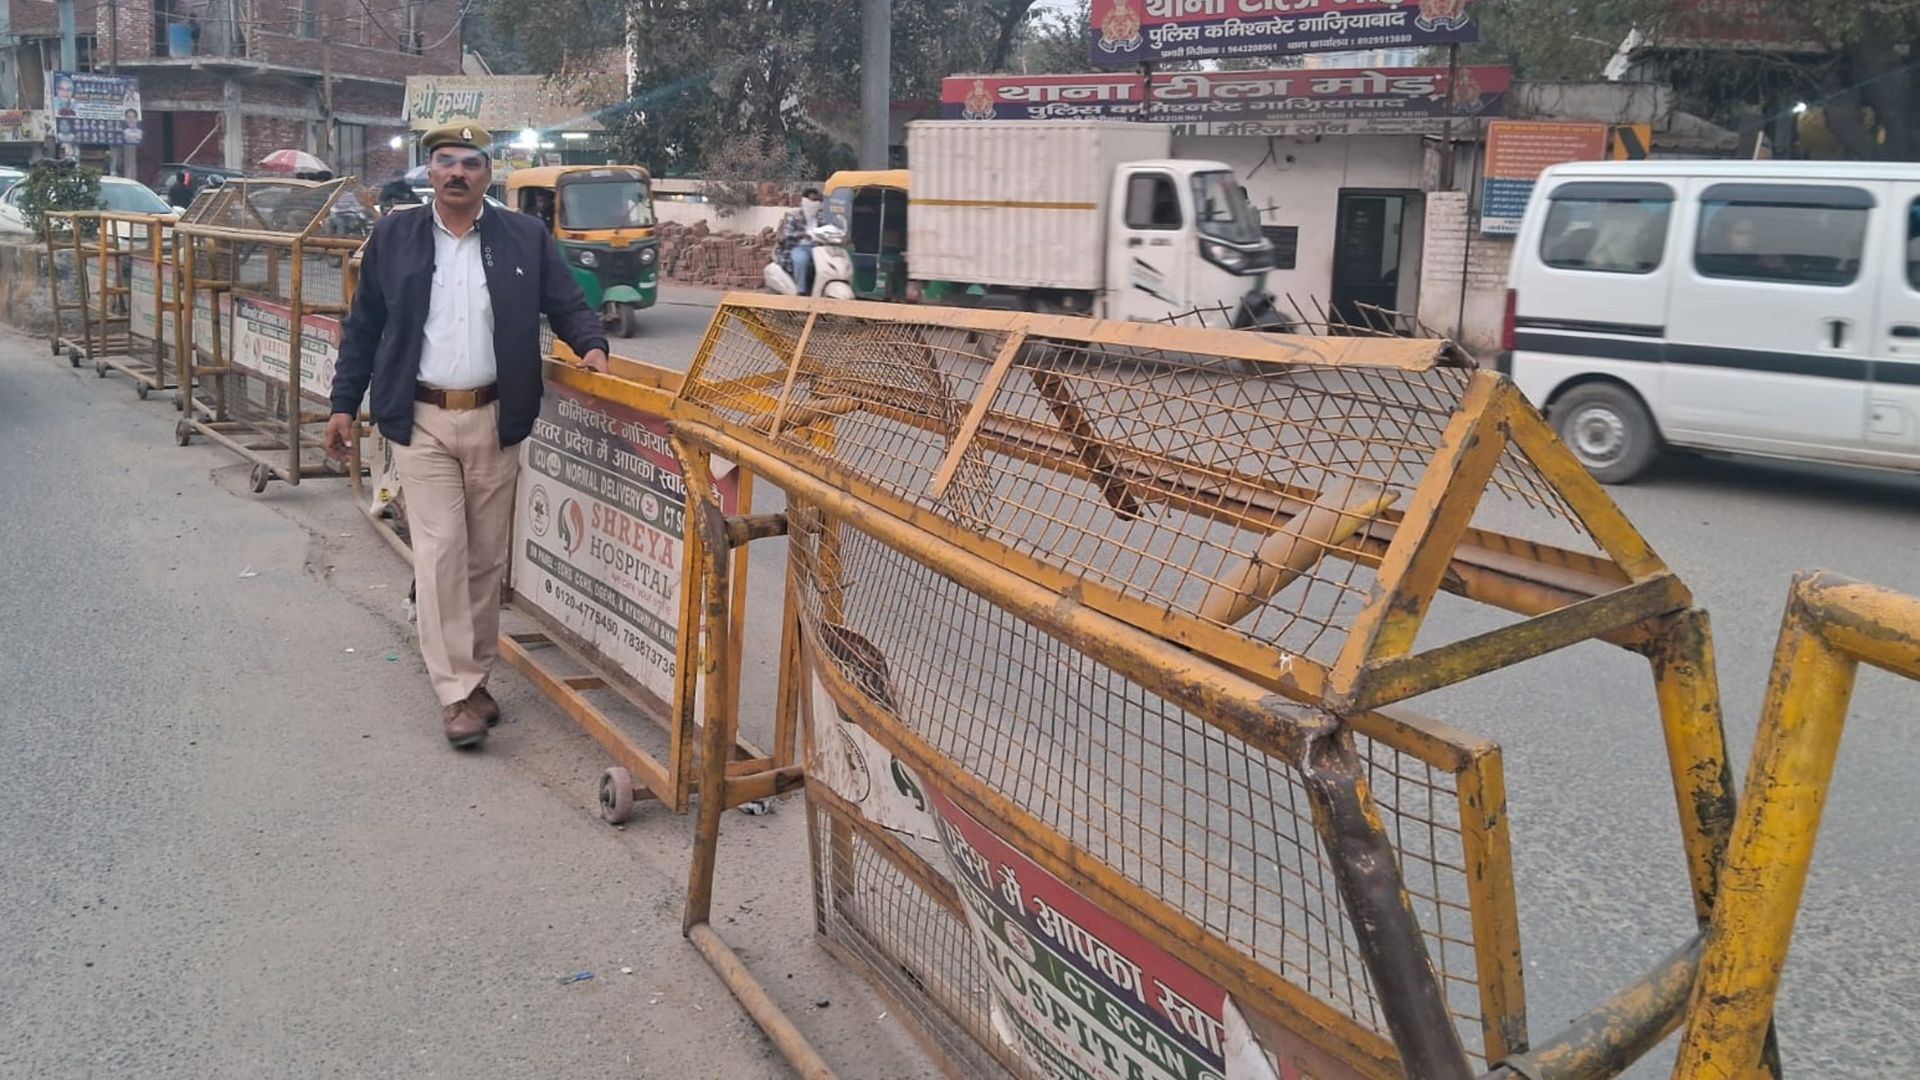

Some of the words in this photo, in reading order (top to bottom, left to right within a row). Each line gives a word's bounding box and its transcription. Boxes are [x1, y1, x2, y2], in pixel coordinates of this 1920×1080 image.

[1148, 22, 1201, 49] पुलिस
[1204, 16, 1295, 39] कमिश्नरेट
[1298, 11, 1408, 35] गाज़ियाबाद
[998, 83, 1136, 102] थाना
[1150, 74, 1294, 99] टीला
[1309, 70, 1437, 98] मोड़
[1026, 103, 1102, 119] पुलिस
[558, 398, 619, 436] कमिश्नरेट
[534, 418, 561, 444] उत्तर
[564, 428, 594, 457] प्रदेश
[596, 436, 609, 462] में
[612, 448, 656, 482] आपका
[565, 460, 599, 491] NORMAL
[600, 473, 641, 509] DELIVERY
[663, 506, 676, 526] CT
[589, 535, 672, 600] HOSPITAL
[591, 501, 675, 570] SHREYA
[624, 629, 676, 678] 783873736
[997, 863, 1026, 918] में
[1033, 896, 1146, 1004] आपका
[1153, 978, 1225, 1058] स्वा
[980, 928, 1152, 1080] HOSPITA
[1063, 970, 1096, 1011] CT
[1104, 1001, 1188, 1080] SCAN
